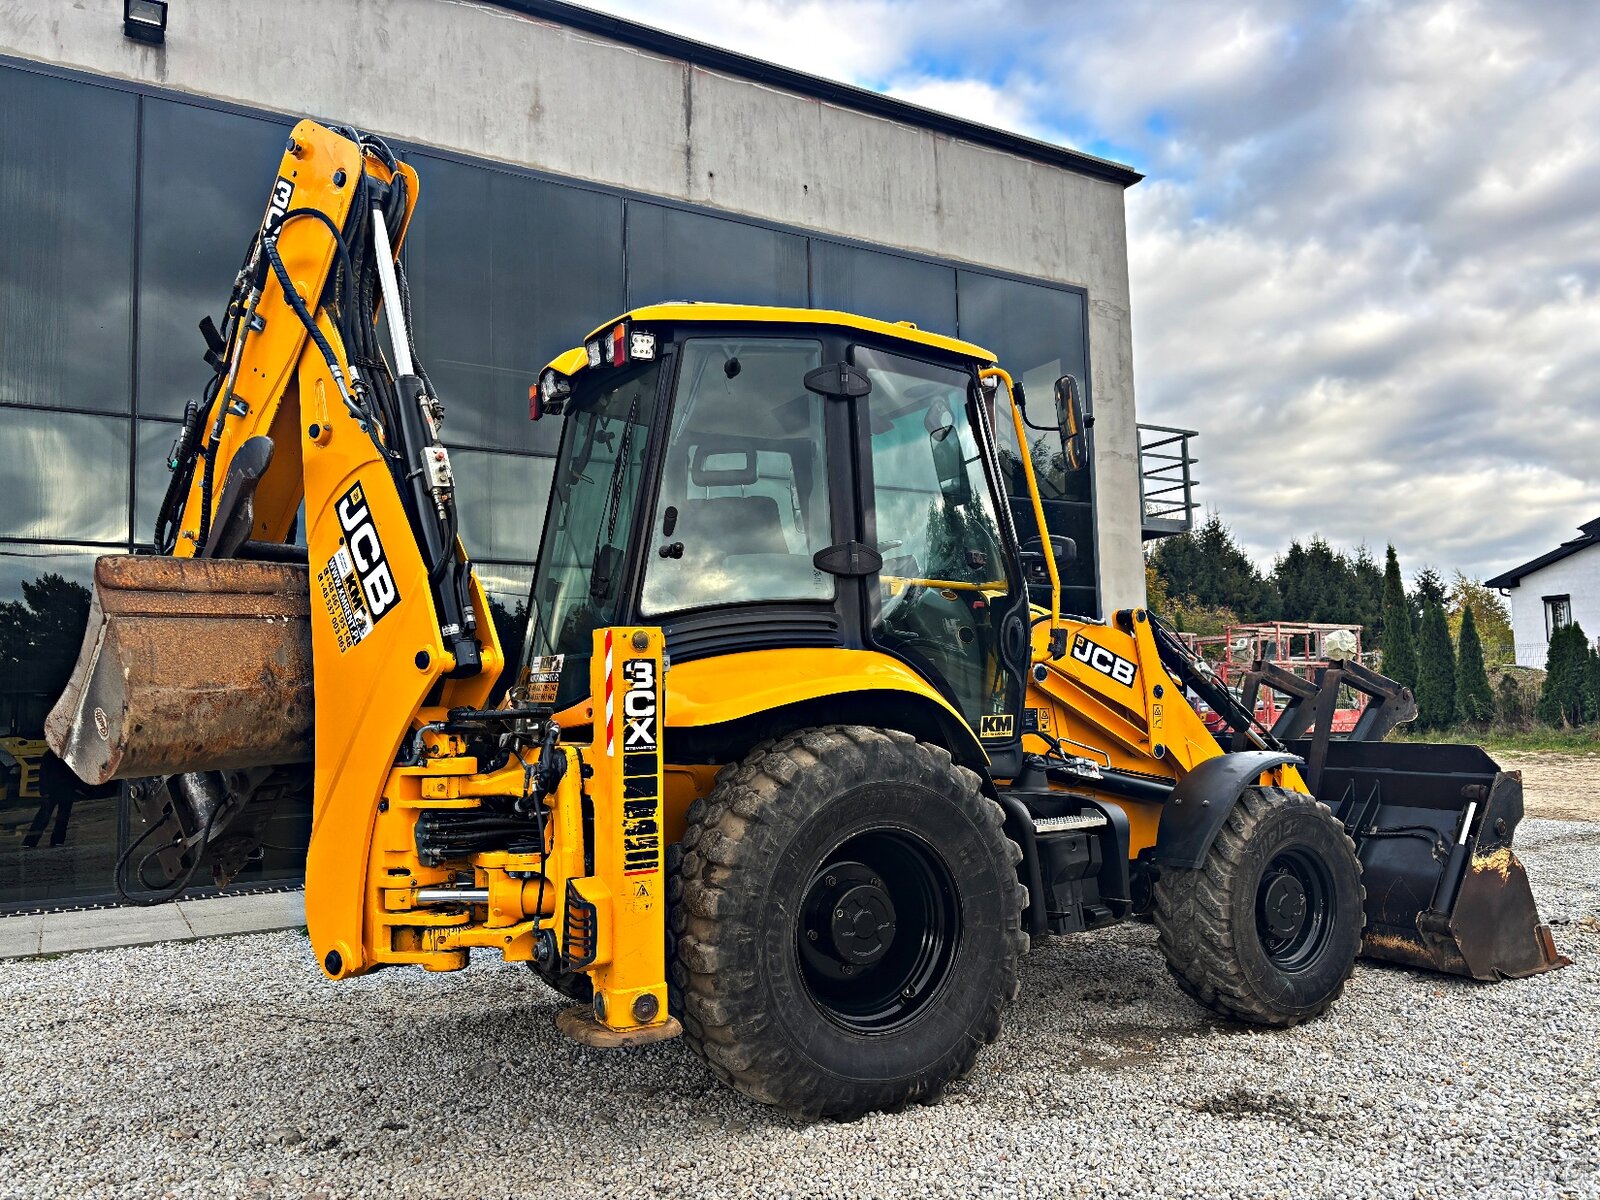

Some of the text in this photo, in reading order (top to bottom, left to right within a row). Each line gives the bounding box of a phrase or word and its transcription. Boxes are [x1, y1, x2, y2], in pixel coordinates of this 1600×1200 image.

[338, 497, 396, 616] JCB
[329, 557, 360, 645] WWW.KMRENT.PL
[345, 571, 363, 612] KM
[332, 594, 340, 611] 661
[337, 612, 346, 629] 195
[344, 630, 352, 648] 148
[337, 635, 346, 653] 063
[1073, 641, 1135, 685] JCB
[624, 661, 656, 745] 3CX
[982, 716, 1011, 732] KM
